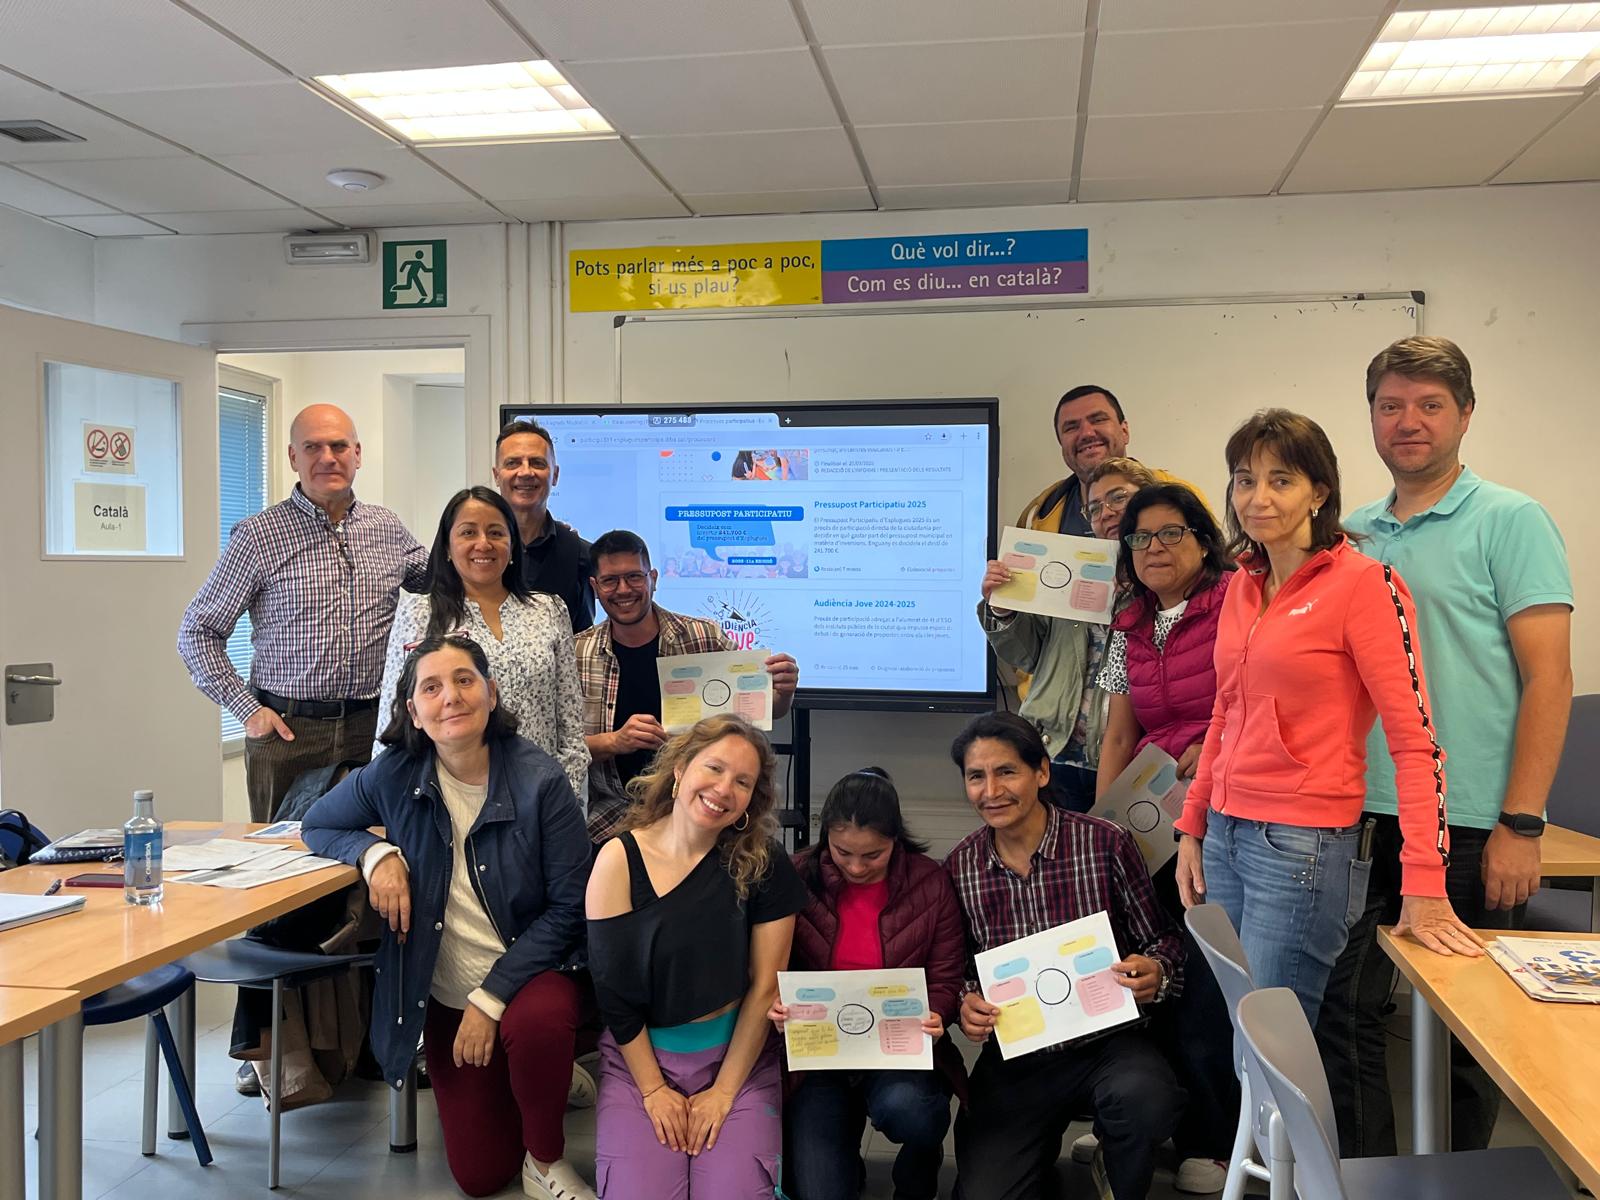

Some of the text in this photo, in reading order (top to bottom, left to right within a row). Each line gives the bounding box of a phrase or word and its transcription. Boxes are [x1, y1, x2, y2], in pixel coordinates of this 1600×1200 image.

[891, 238, 1016, 260] Què vol dir...?
[575, 255, 816, 279] Pots parlar més a poc a poc,
[847, 267, 1063, 292] Com es diu... en català?
[649, 276, 740, 298] si us plau?
[93, 504, 129, 518] Català
[814, 501, 858, 509] Pressupost
[859, 500, 906, 509] Participatiu
[678, 510, 793, 518] PRESSUPOST PARTICIPATIU
[100, 522, 122, 531] Aula-1
[814, 598, 916, 608] Audiència Jove 2024-2025
[721, 619, 757, 632] DIÈNCIA
[726, 630, 755, 651] ove
